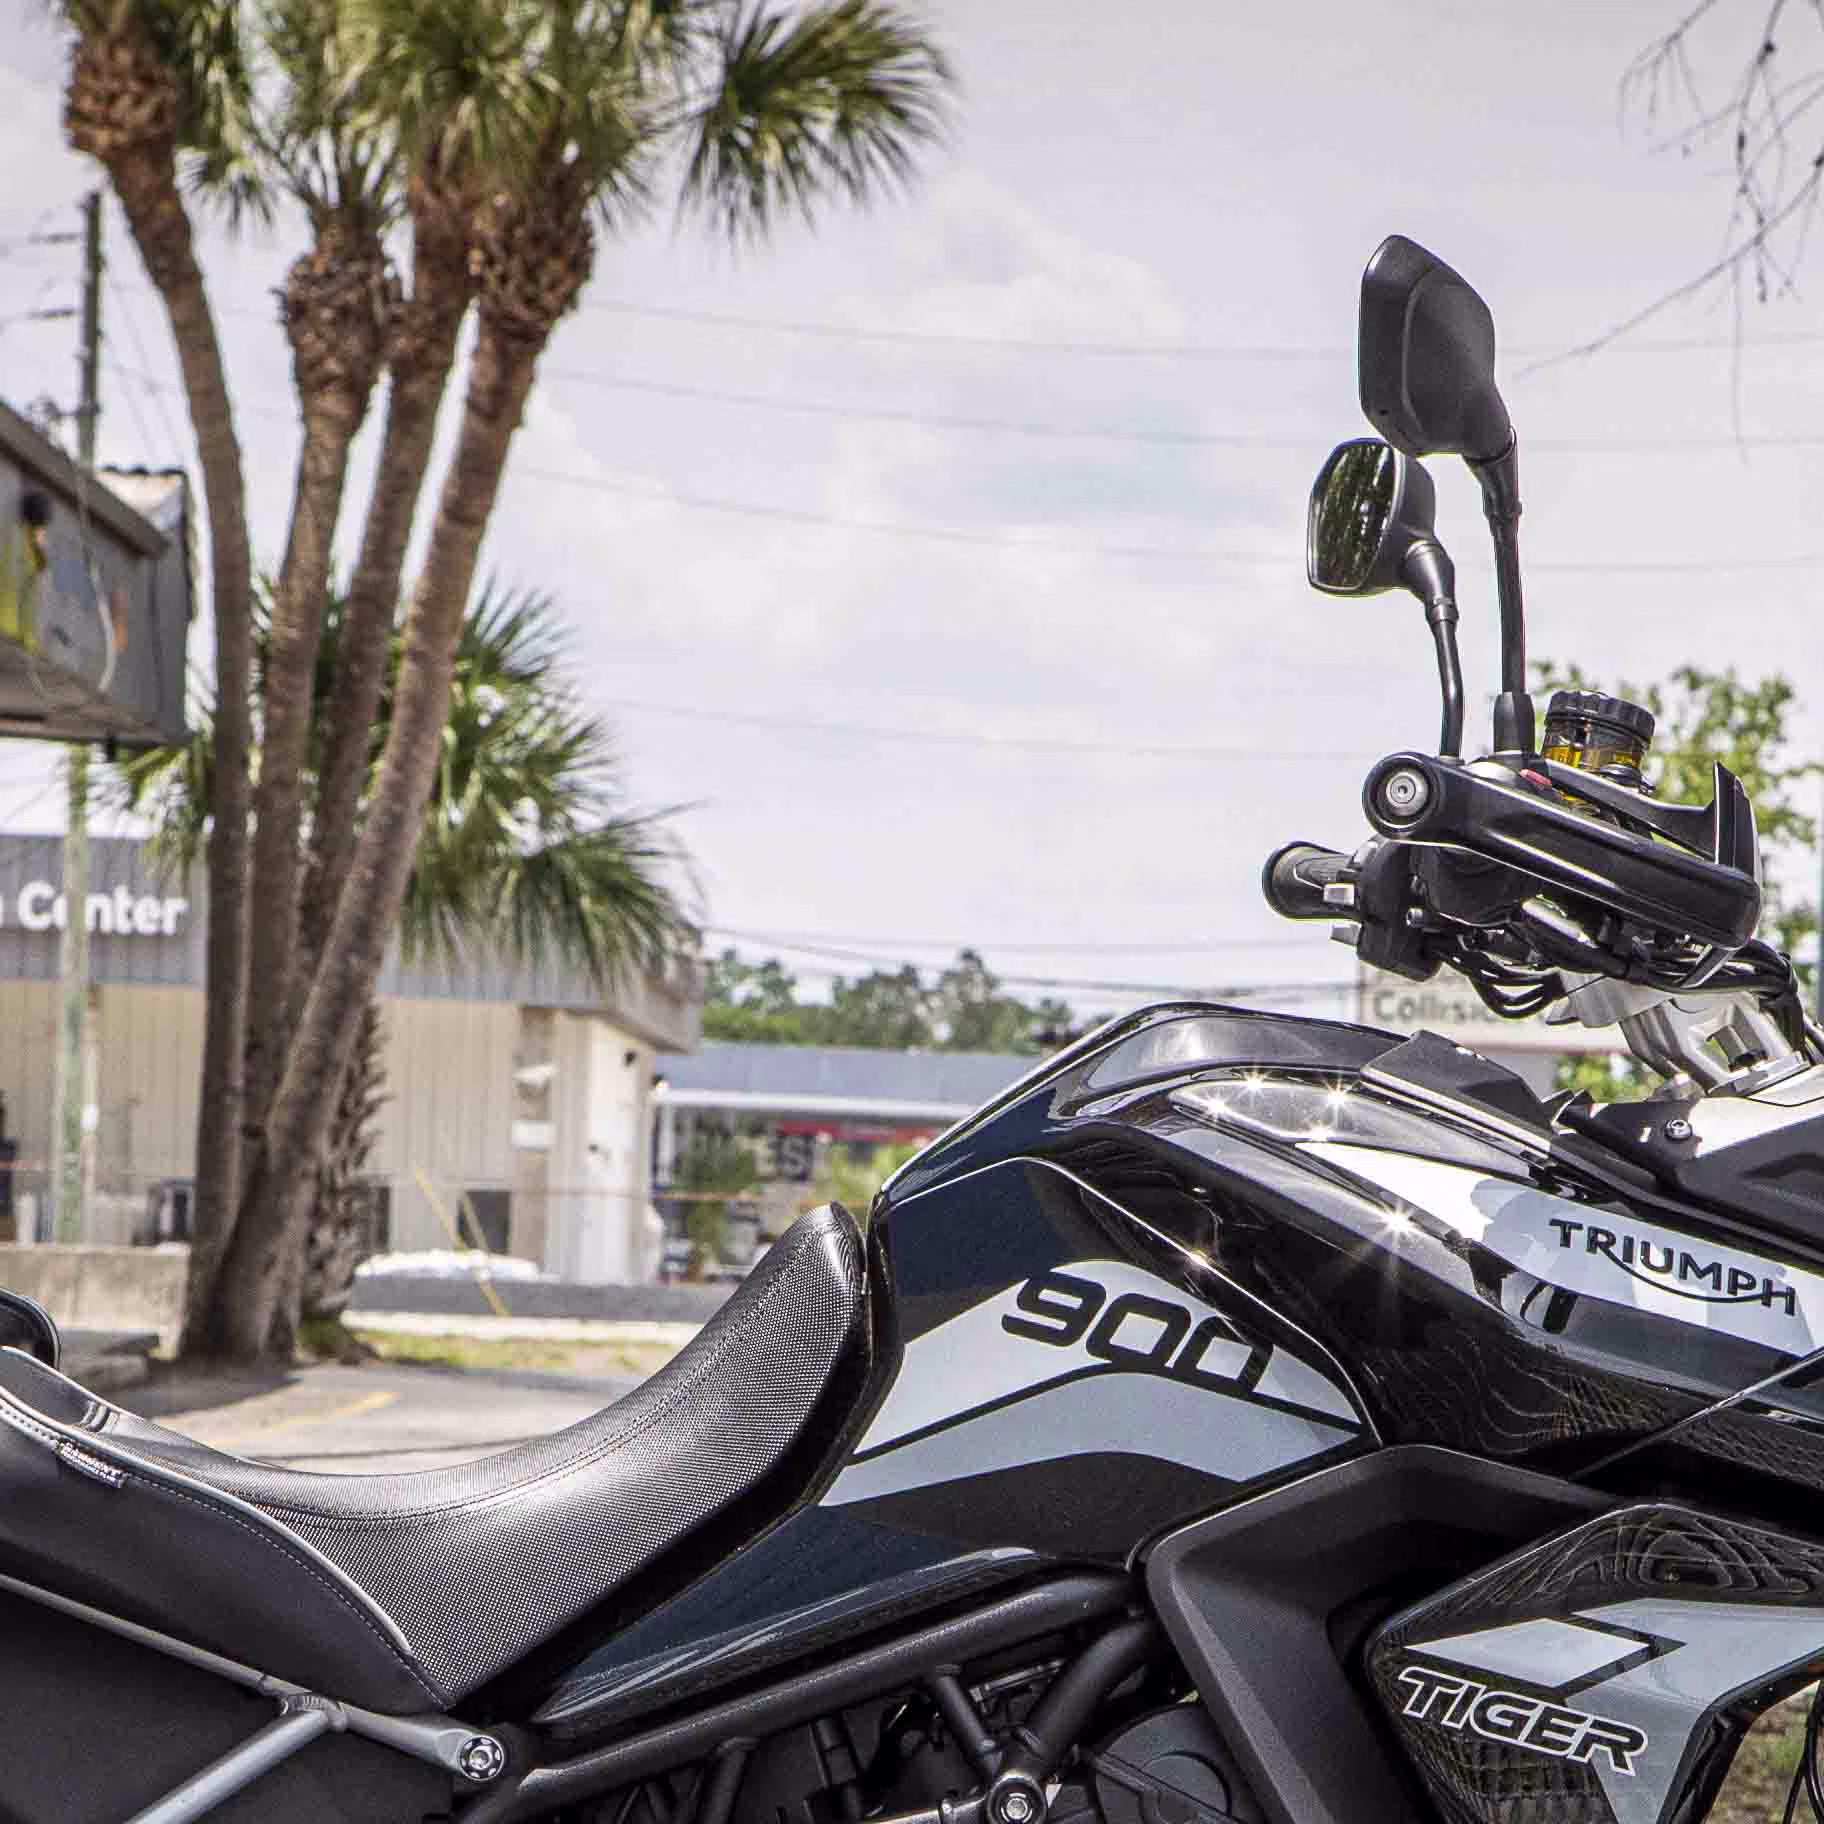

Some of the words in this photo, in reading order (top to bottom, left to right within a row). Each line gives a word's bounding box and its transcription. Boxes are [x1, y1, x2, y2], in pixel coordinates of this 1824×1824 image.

[1548, 1217, 1796, 1318] TRIUMPH
[1001, 1268, 1275, 1395] 900
[1397, 1665, 1650, 1777] TIGER
